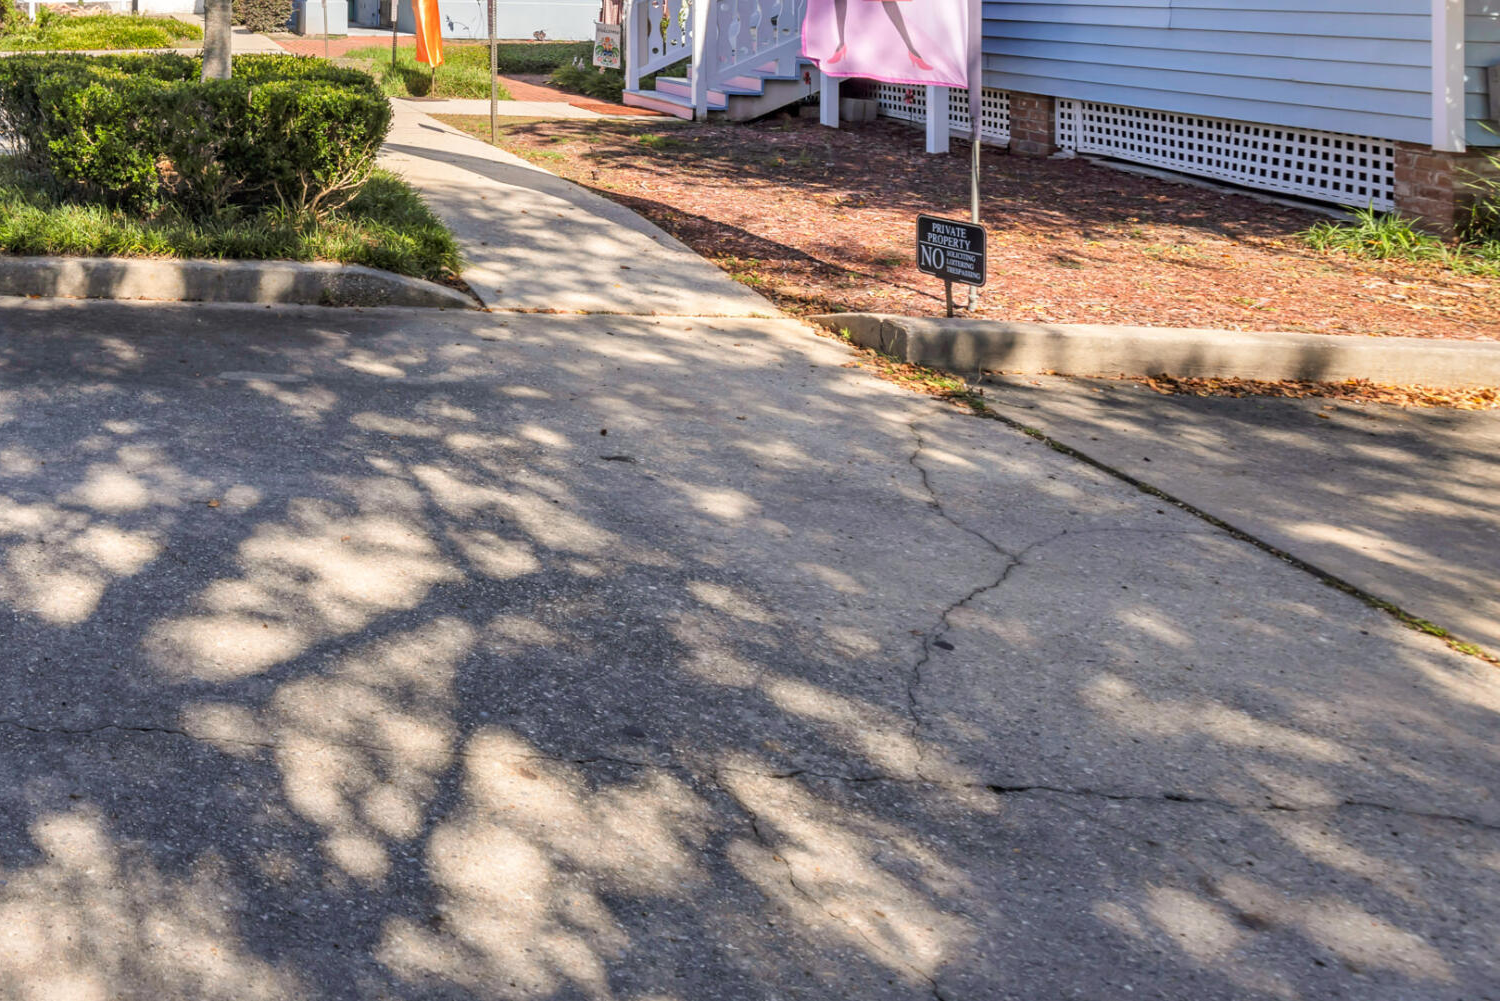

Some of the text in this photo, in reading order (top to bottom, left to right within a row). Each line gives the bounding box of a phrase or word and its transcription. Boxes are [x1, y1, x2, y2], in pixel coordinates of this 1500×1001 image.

[931, 222, 967, 239] PRIVATE
[927, 232, 971, 250] PROPERTY
[920, 244, 945, 270] NO
